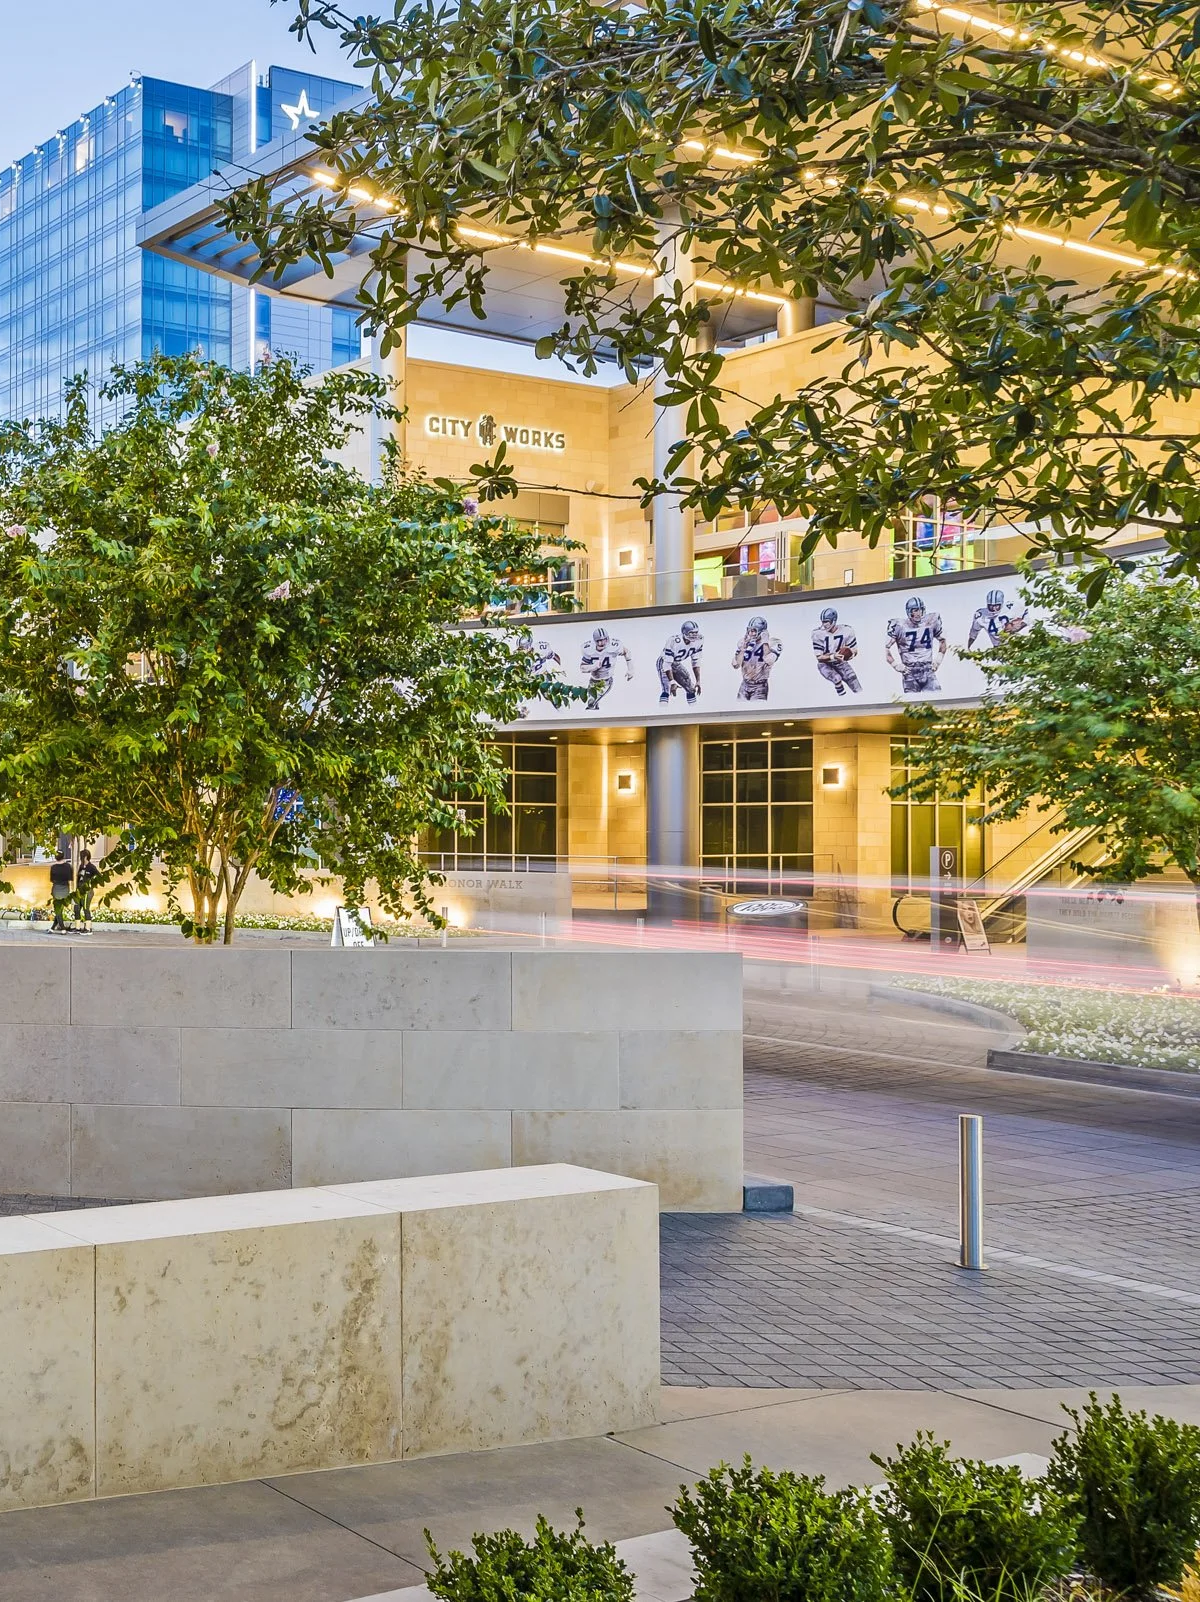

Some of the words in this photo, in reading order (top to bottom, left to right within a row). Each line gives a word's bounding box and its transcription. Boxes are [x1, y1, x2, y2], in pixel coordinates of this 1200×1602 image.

[428, 417, 472, 437] CITY
[504, 426, 565, 449] WORKS
[823, 635, 843, 654] 17
[905, 627, 932, 652] 74
[488, 880, 523, 889] WALK
